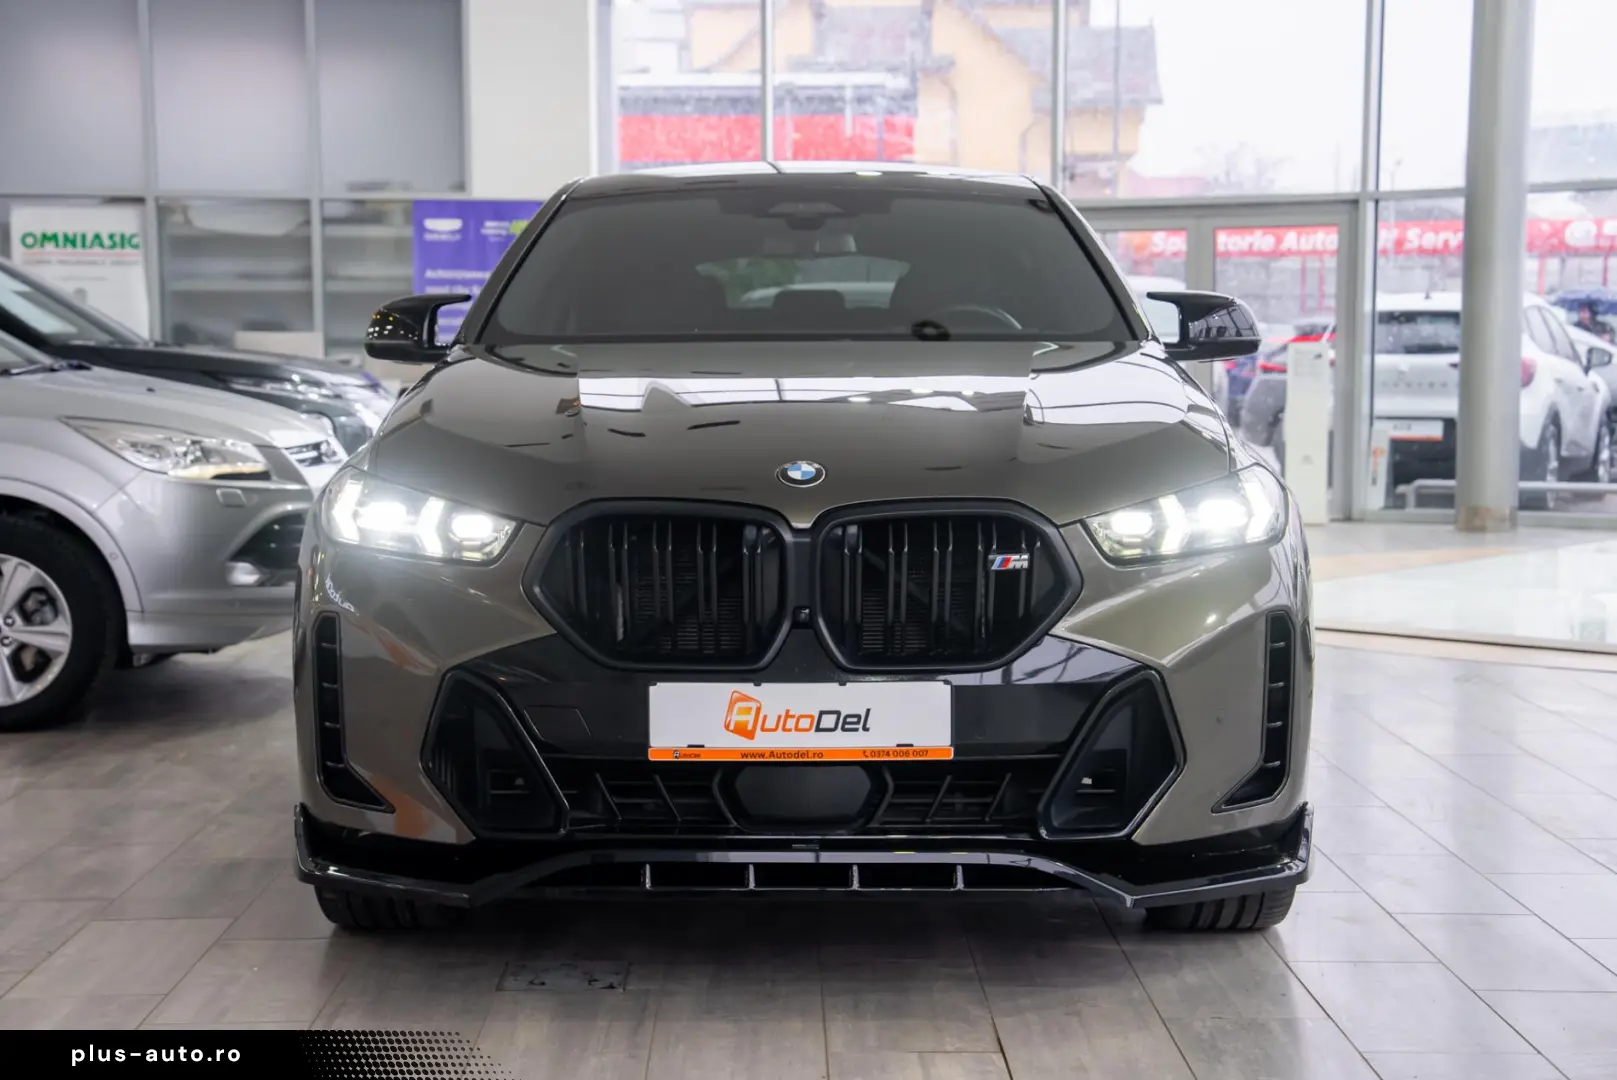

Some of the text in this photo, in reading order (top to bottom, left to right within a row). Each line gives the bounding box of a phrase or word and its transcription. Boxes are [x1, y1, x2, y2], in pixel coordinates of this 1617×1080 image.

[21, 231, 140, 250] OMNIASIG
[730, 701, 871, 733] AutoDel
[740, 750, 824, 760] www.Autodel.ro
[870, 749, 890, 759] 0374
[892, 749, 910, 759] 006
[912, 749, 929, 758] 007
